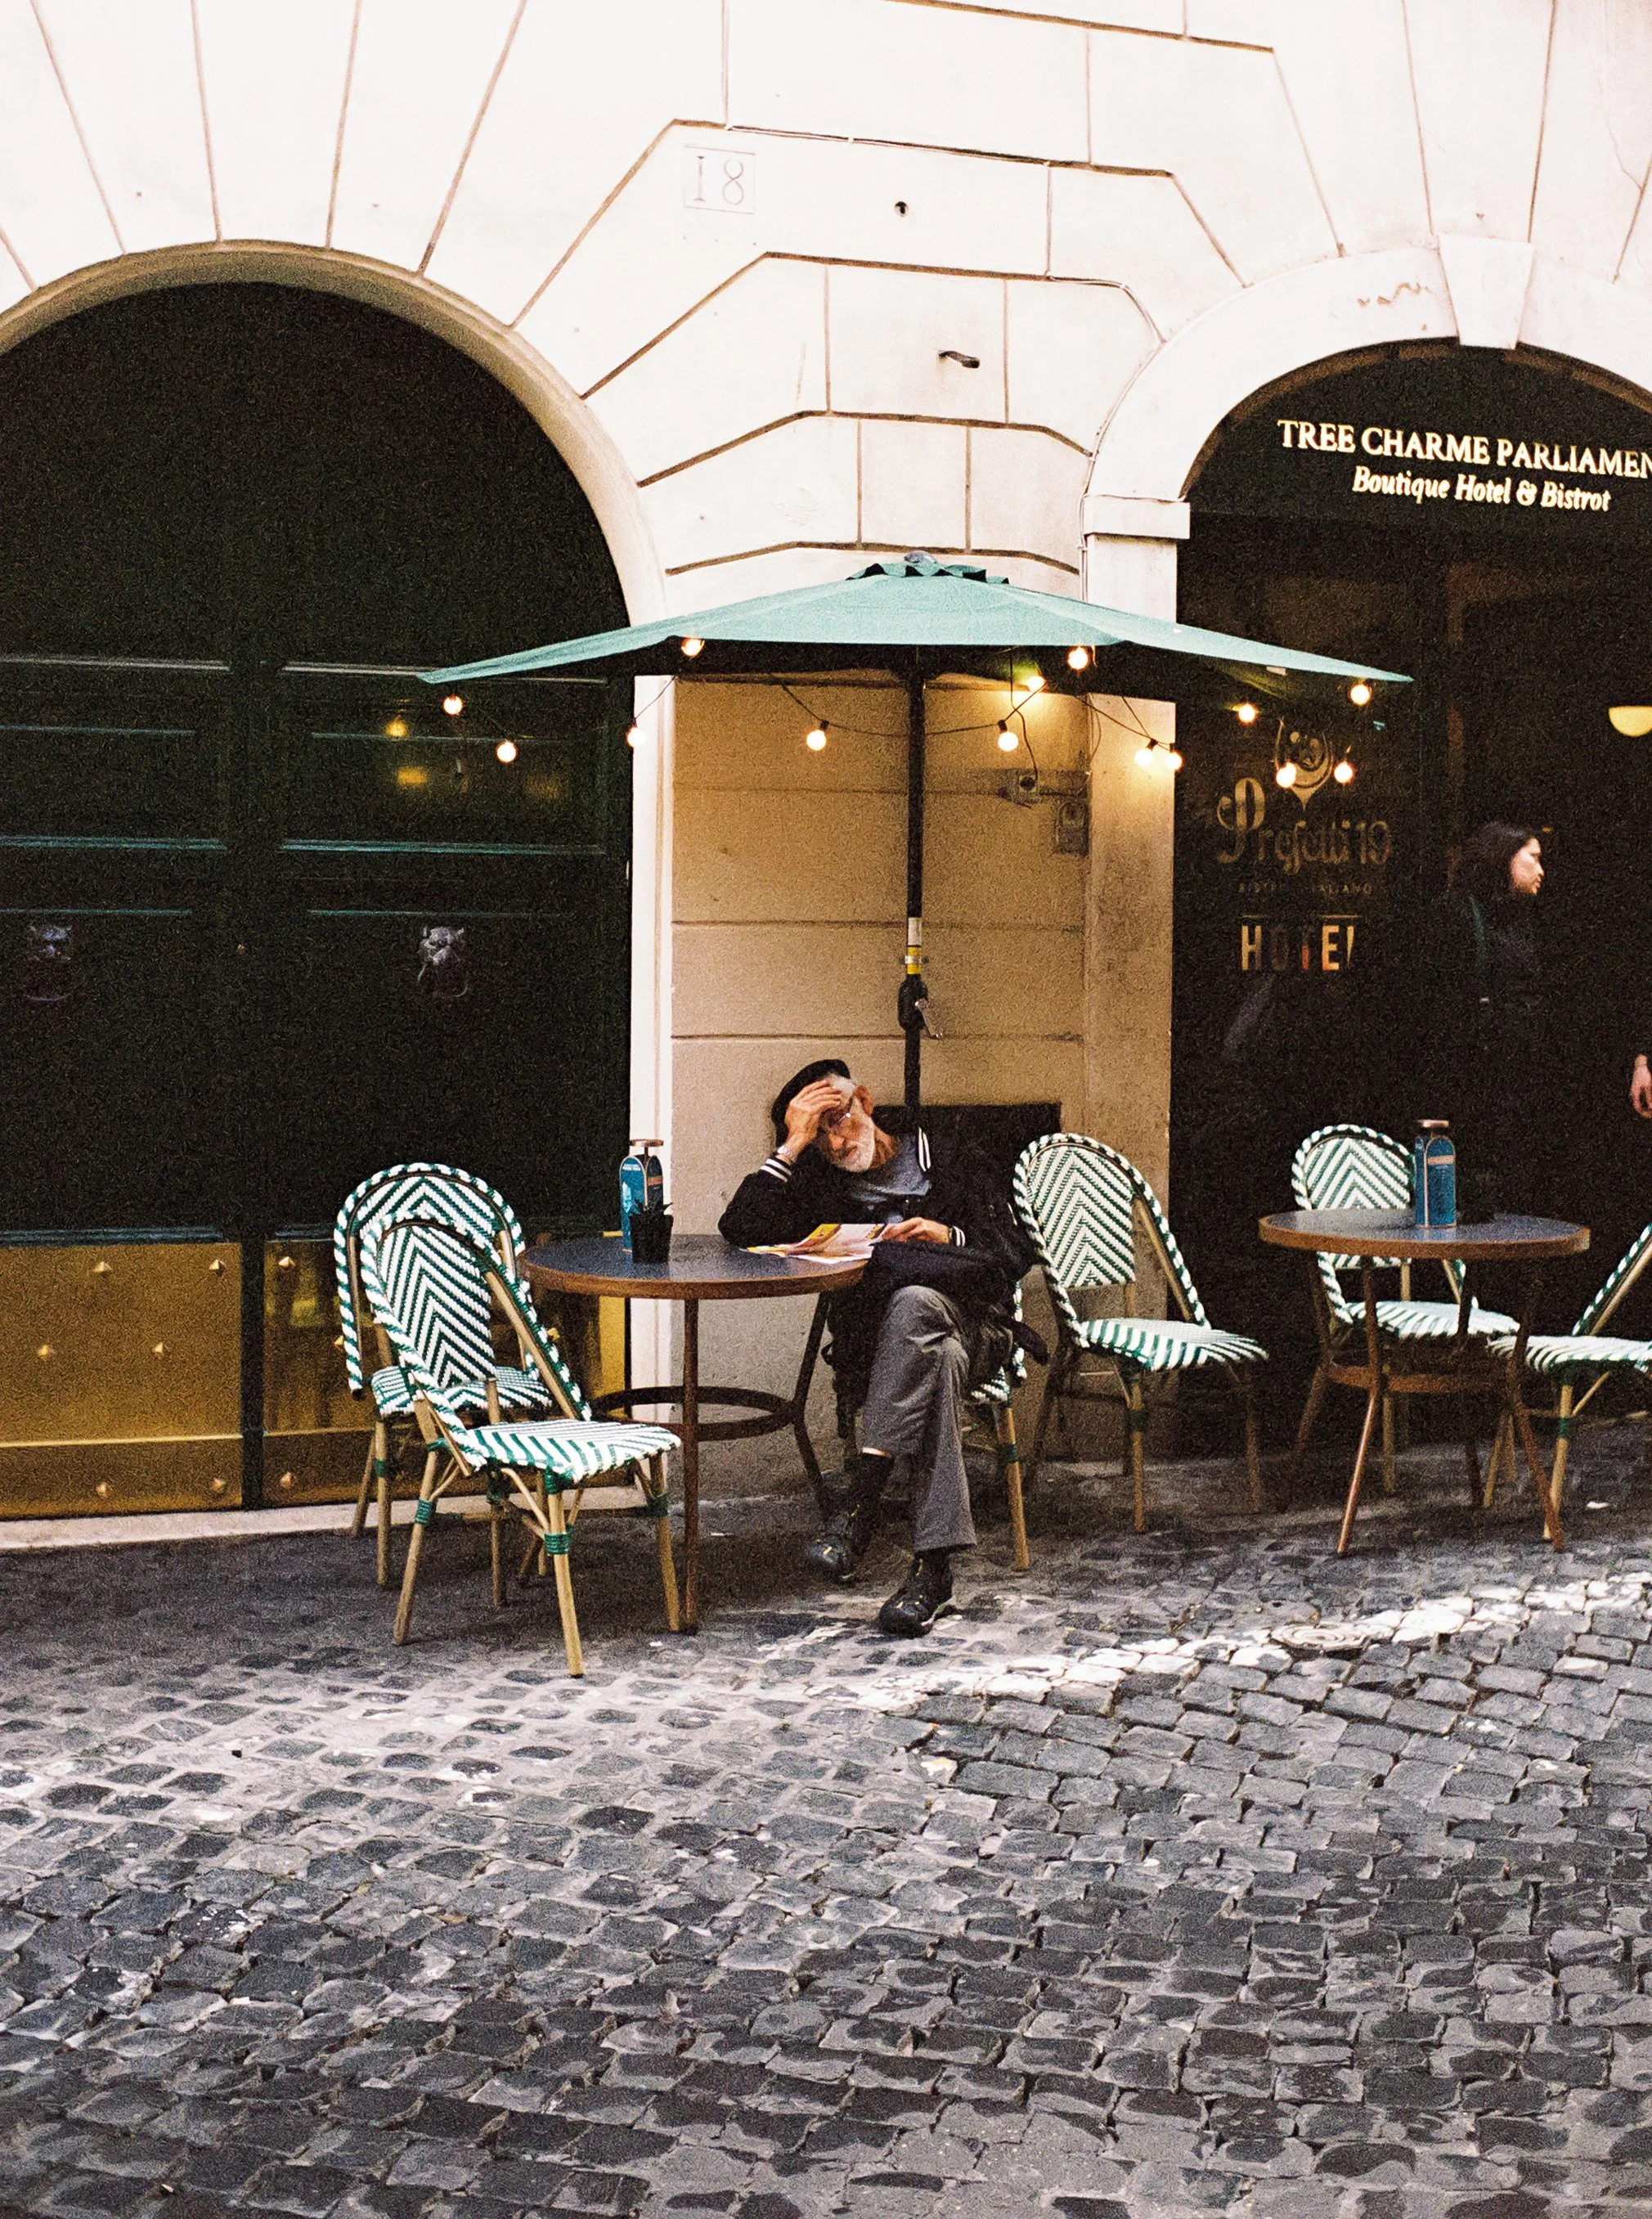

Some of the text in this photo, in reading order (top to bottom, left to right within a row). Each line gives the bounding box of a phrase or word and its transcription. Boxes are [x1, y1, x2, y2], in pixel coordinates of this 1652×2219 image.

[694, 155, 744, 205] 18
[1277, 419, 1356, 453] TREE
[1361, 427, 1491, 465] CHARME
[1351, 465, 1612, 512] Boutique Hotel & Bistrot
